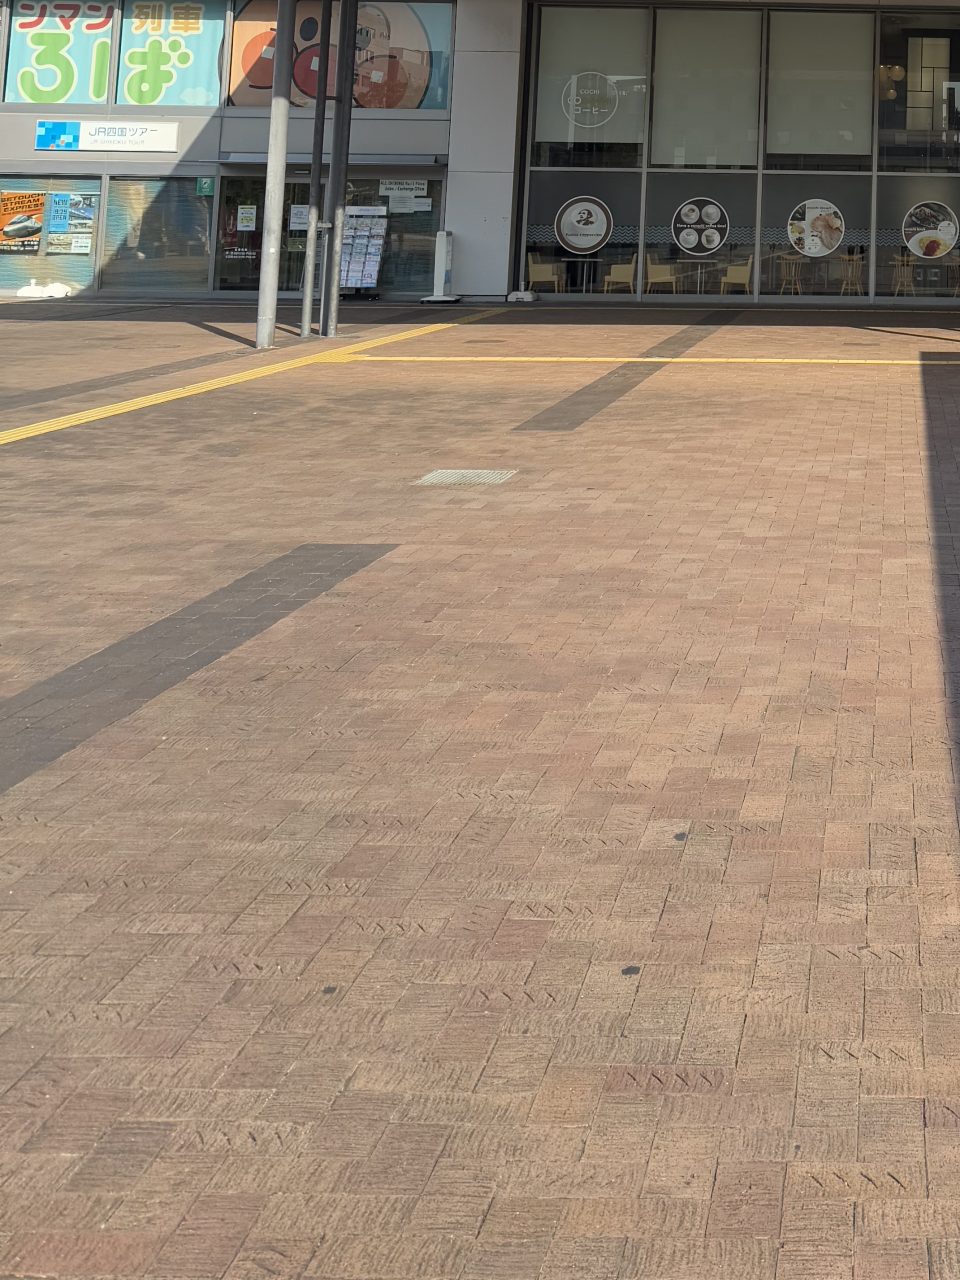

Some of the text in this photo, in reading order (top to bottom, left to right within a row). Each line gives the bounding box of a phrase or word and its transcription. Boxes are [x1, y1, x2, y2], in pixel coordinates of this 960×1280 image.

[133, 4, 202, 33] 列車
[89, 126, 158, 137] JR四国ツアー
